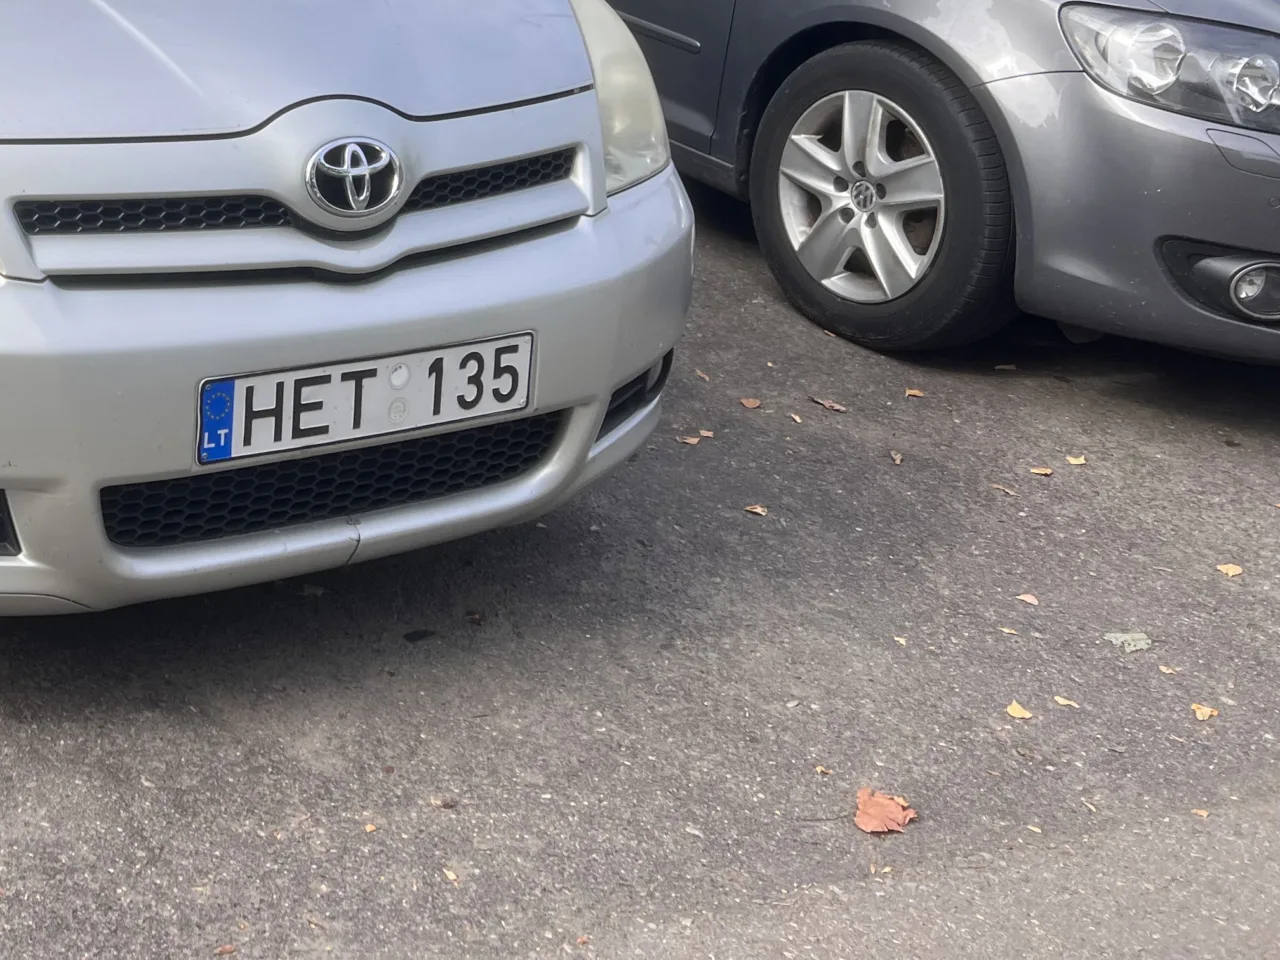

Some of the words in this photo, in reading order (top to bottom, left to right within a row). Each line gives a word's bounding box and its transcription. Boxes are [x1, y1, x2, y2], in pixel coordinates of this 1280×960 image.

[242, 368, 378, 447] HET
[427, 344, 519, 416] 135
[203, 429, 229, 449] LT
